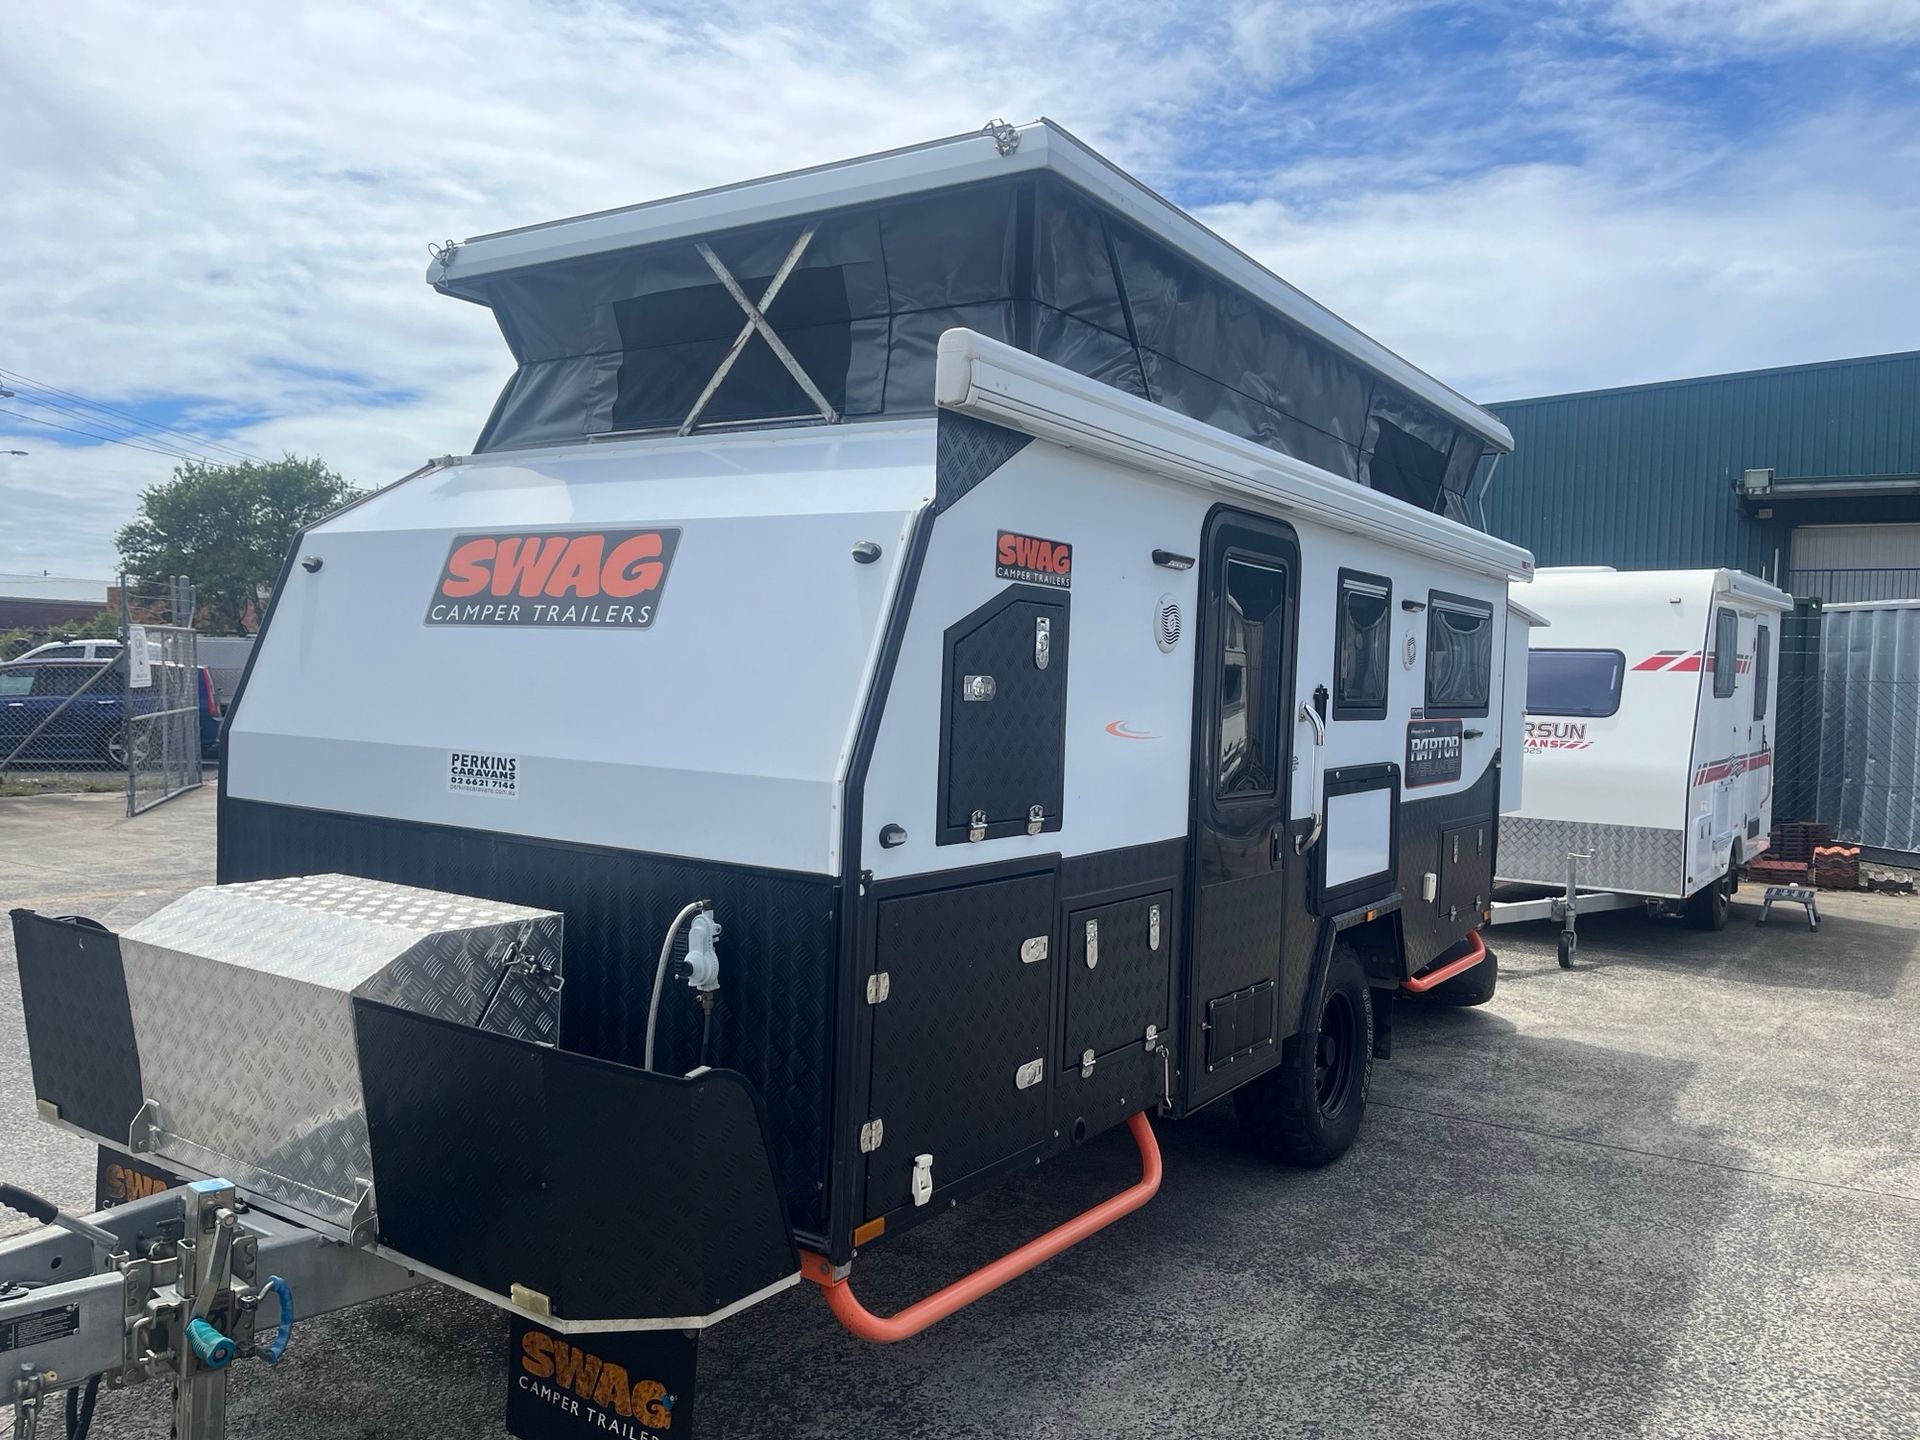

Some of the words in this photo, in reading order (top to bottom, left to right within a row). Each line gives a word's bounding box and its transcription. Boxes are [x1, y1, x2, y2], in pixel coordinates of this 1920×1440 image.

[998, 534, 1070, 574] SWAG
[442, 534, 664, 597] SWAG
[996, 567, 1031, 580] CAMPER
[1034, 573, 1070, 587] TRAILERS
[431, 604, 520, 621] CAMPER
[533, 605, 651, 623] TRAILERS
[1411, 736, 1459, 761] RAPTOR
[451, 753, 516, 771] PERKINS
[450, 776, 463, 784] 02
[465, 778, 489, 787] 6621
[492, 780, 516, 789] 7146
[451, 767, 516, 780] CARAVANS
[522, 1331, 672, 1430] SWAG
[518, 1376, 579, 1416] CAMPER
